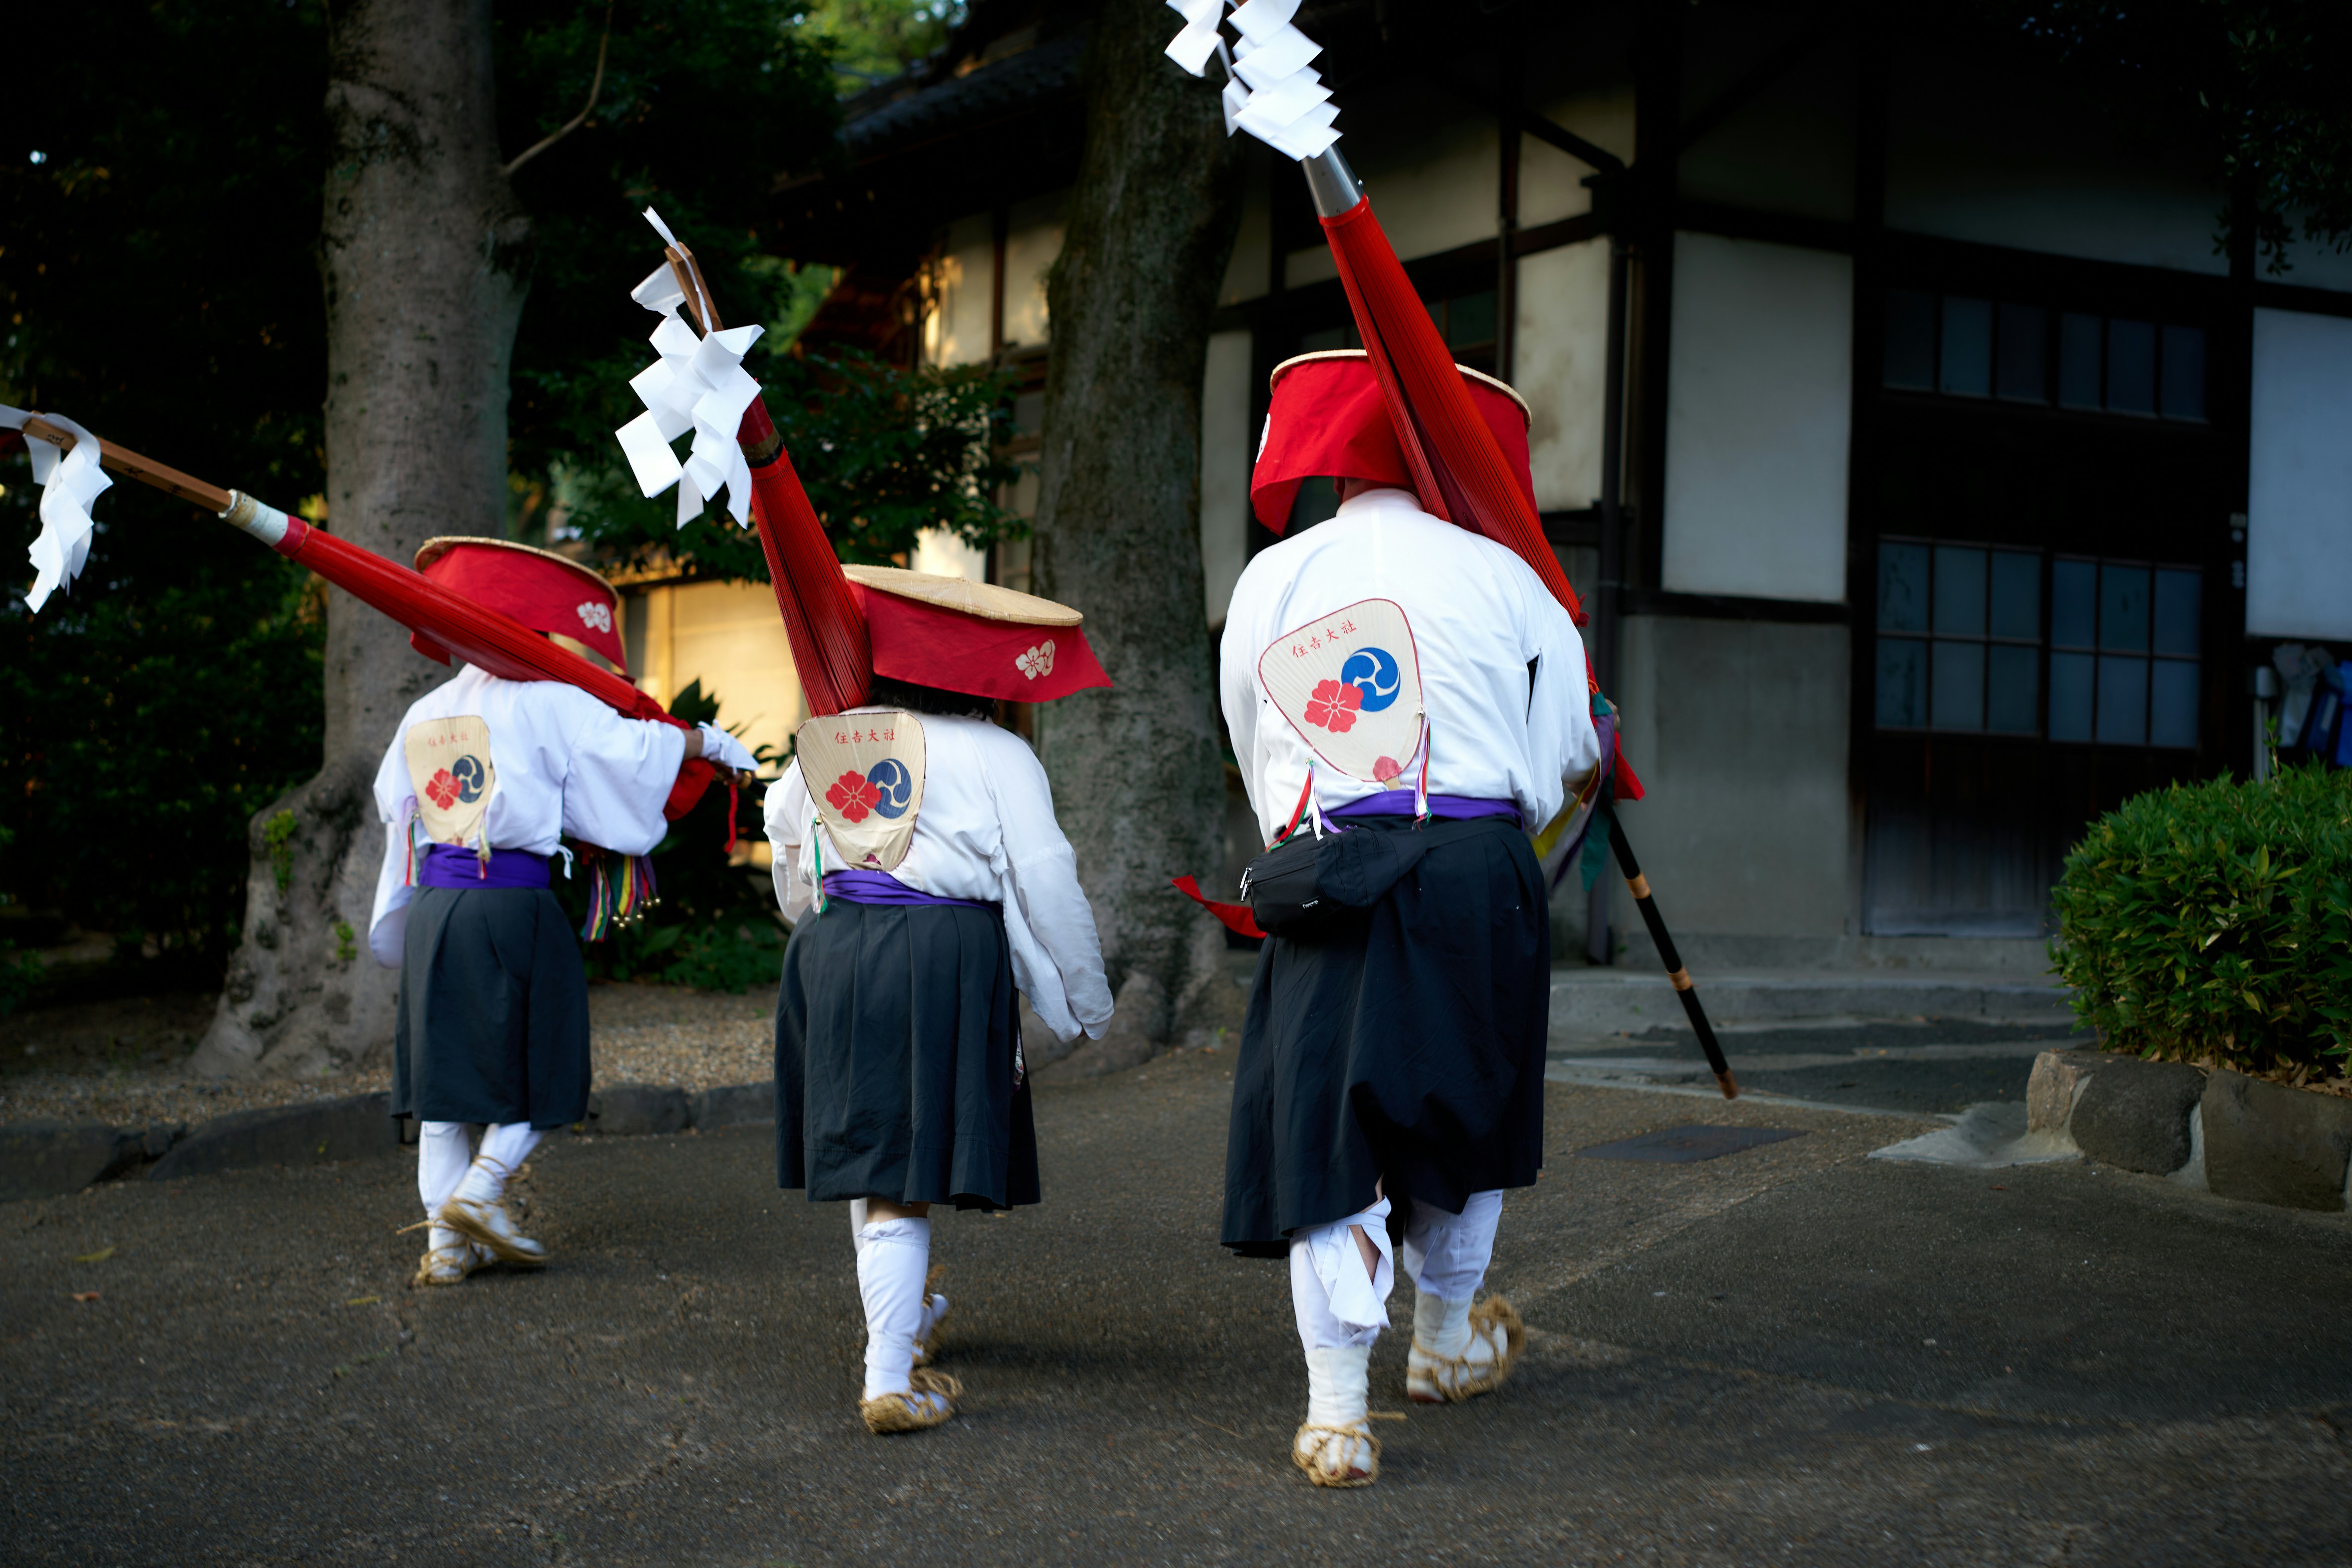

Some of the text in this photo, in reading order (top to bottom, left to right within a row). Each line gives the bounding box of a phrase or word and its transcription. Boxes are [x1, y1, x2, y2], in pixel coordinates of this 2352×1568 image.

[1293, 619, 1357, 658] 住吉大社
[834, 728, 895, 744] 住吉大社
